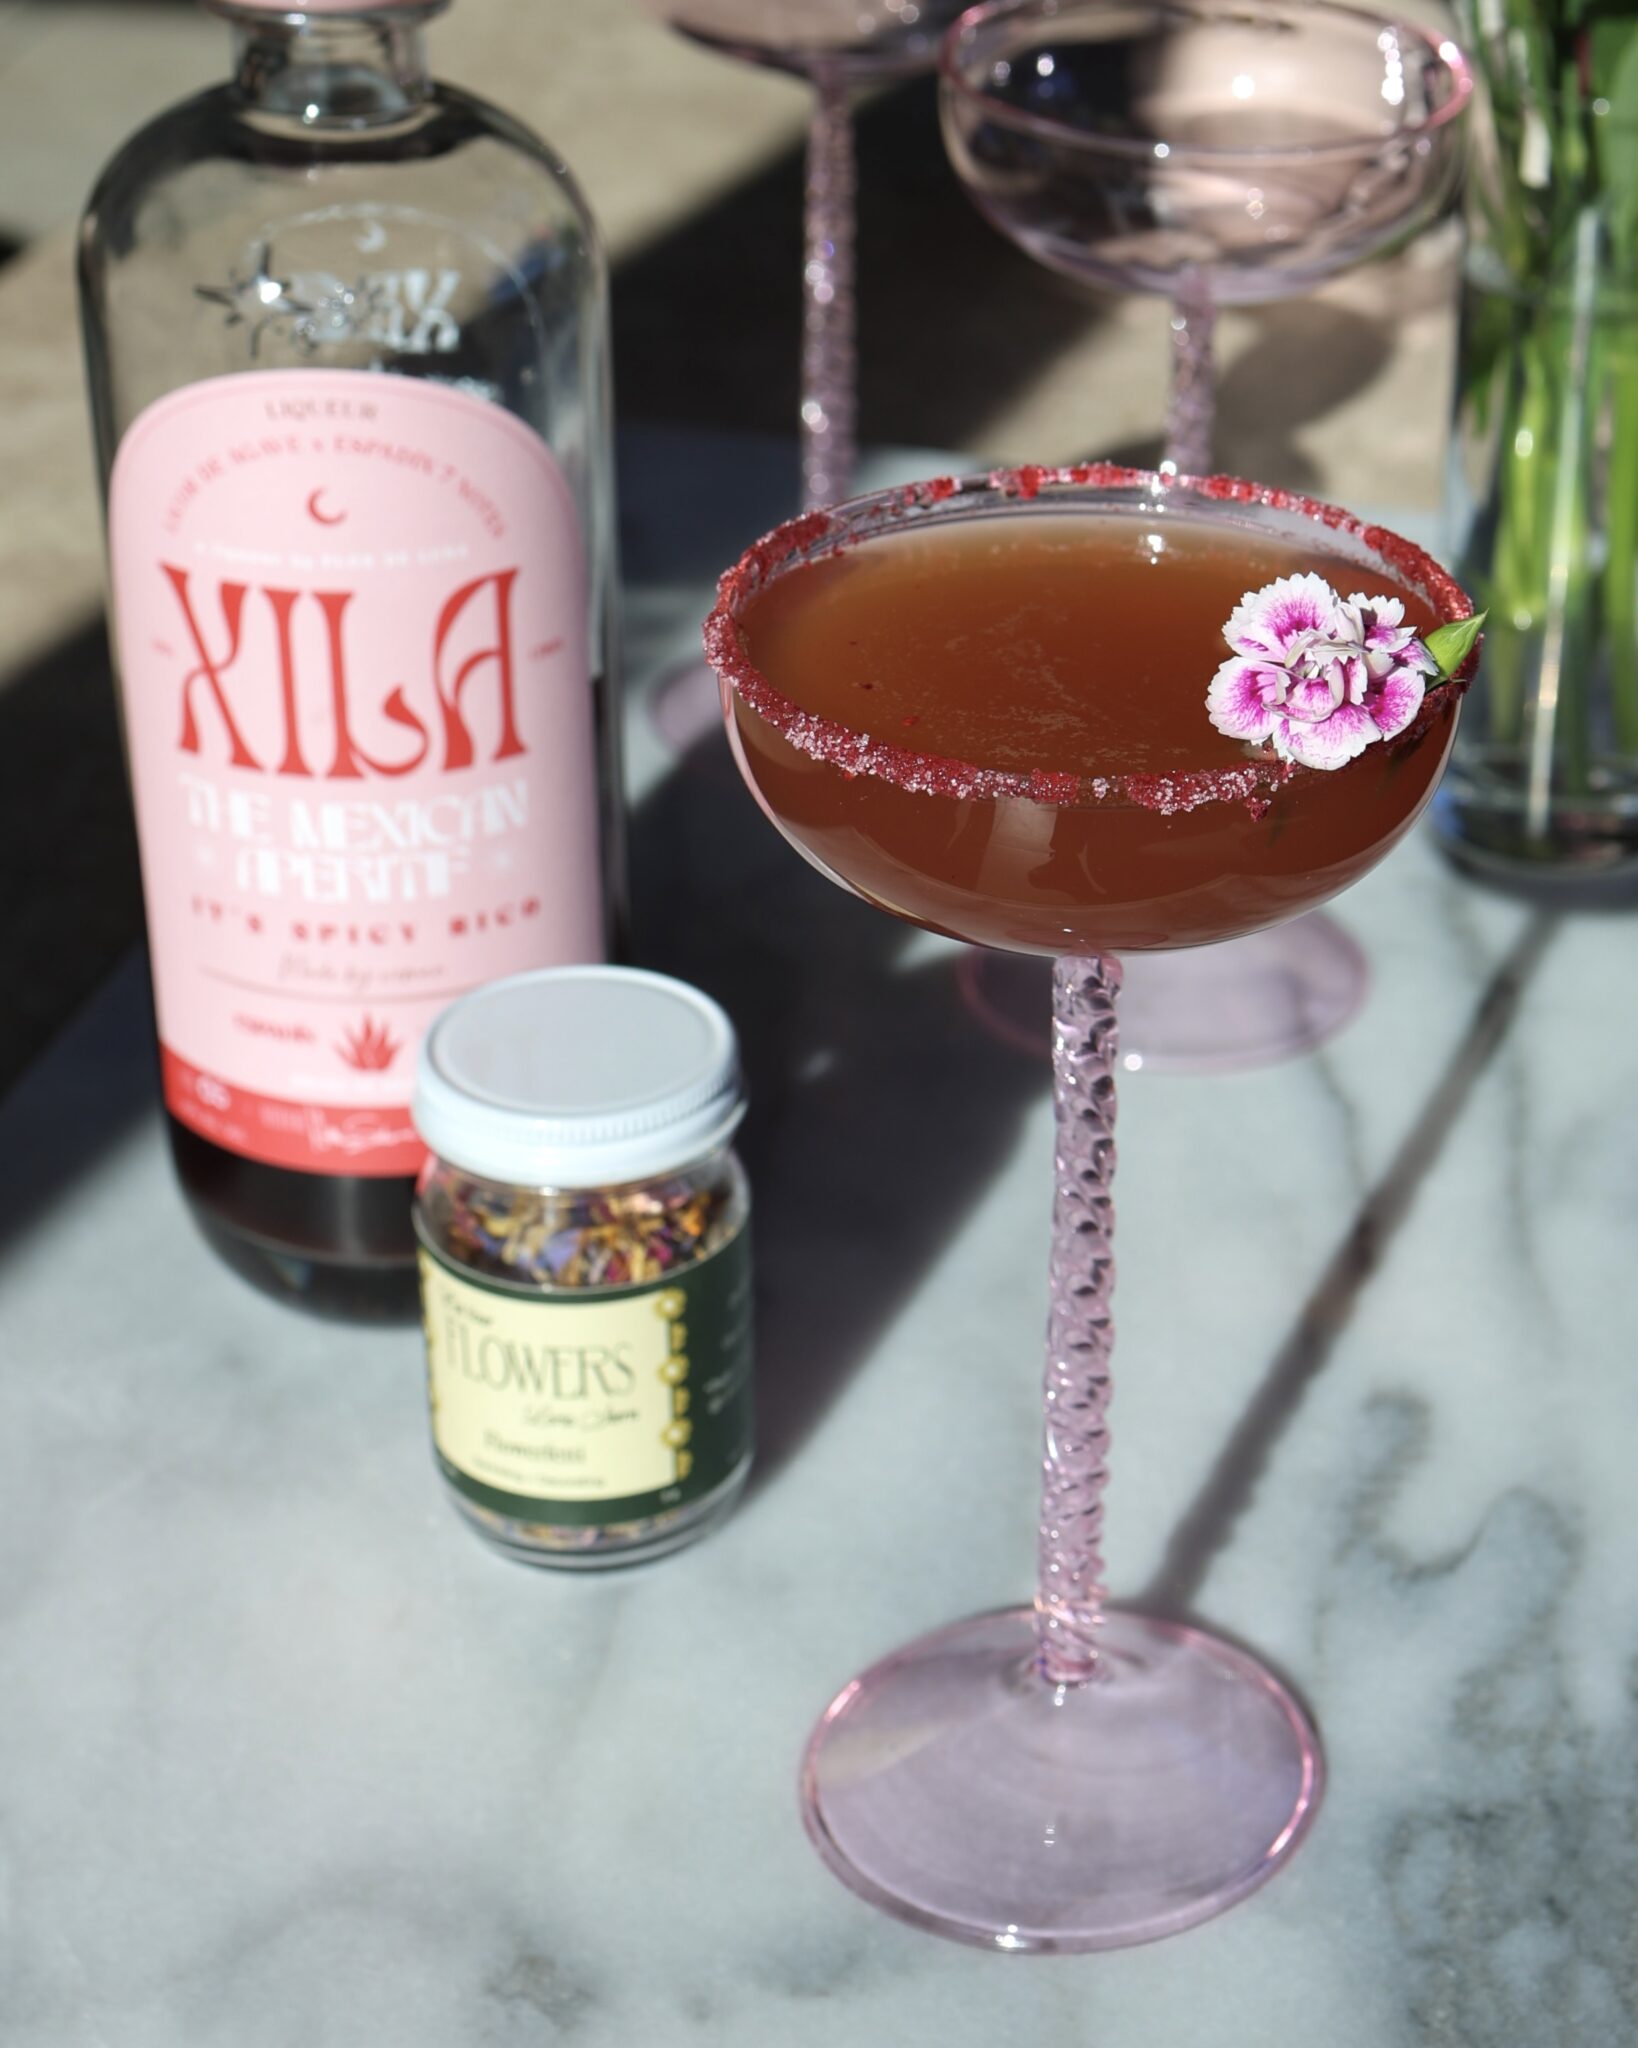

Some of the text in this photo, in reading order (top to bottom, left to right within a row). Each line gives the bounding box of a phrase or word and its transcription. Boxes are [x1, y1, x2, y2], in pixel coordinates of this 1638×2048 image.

[159, 561, 528, 780] XILA
[179, 774, 528, 848] THE MEXICAN
[190, 892, 263, 935] IT'S
[290, 918, 415, 946] SPICY
[446, 1315, 638, 1400] FLOWERS
